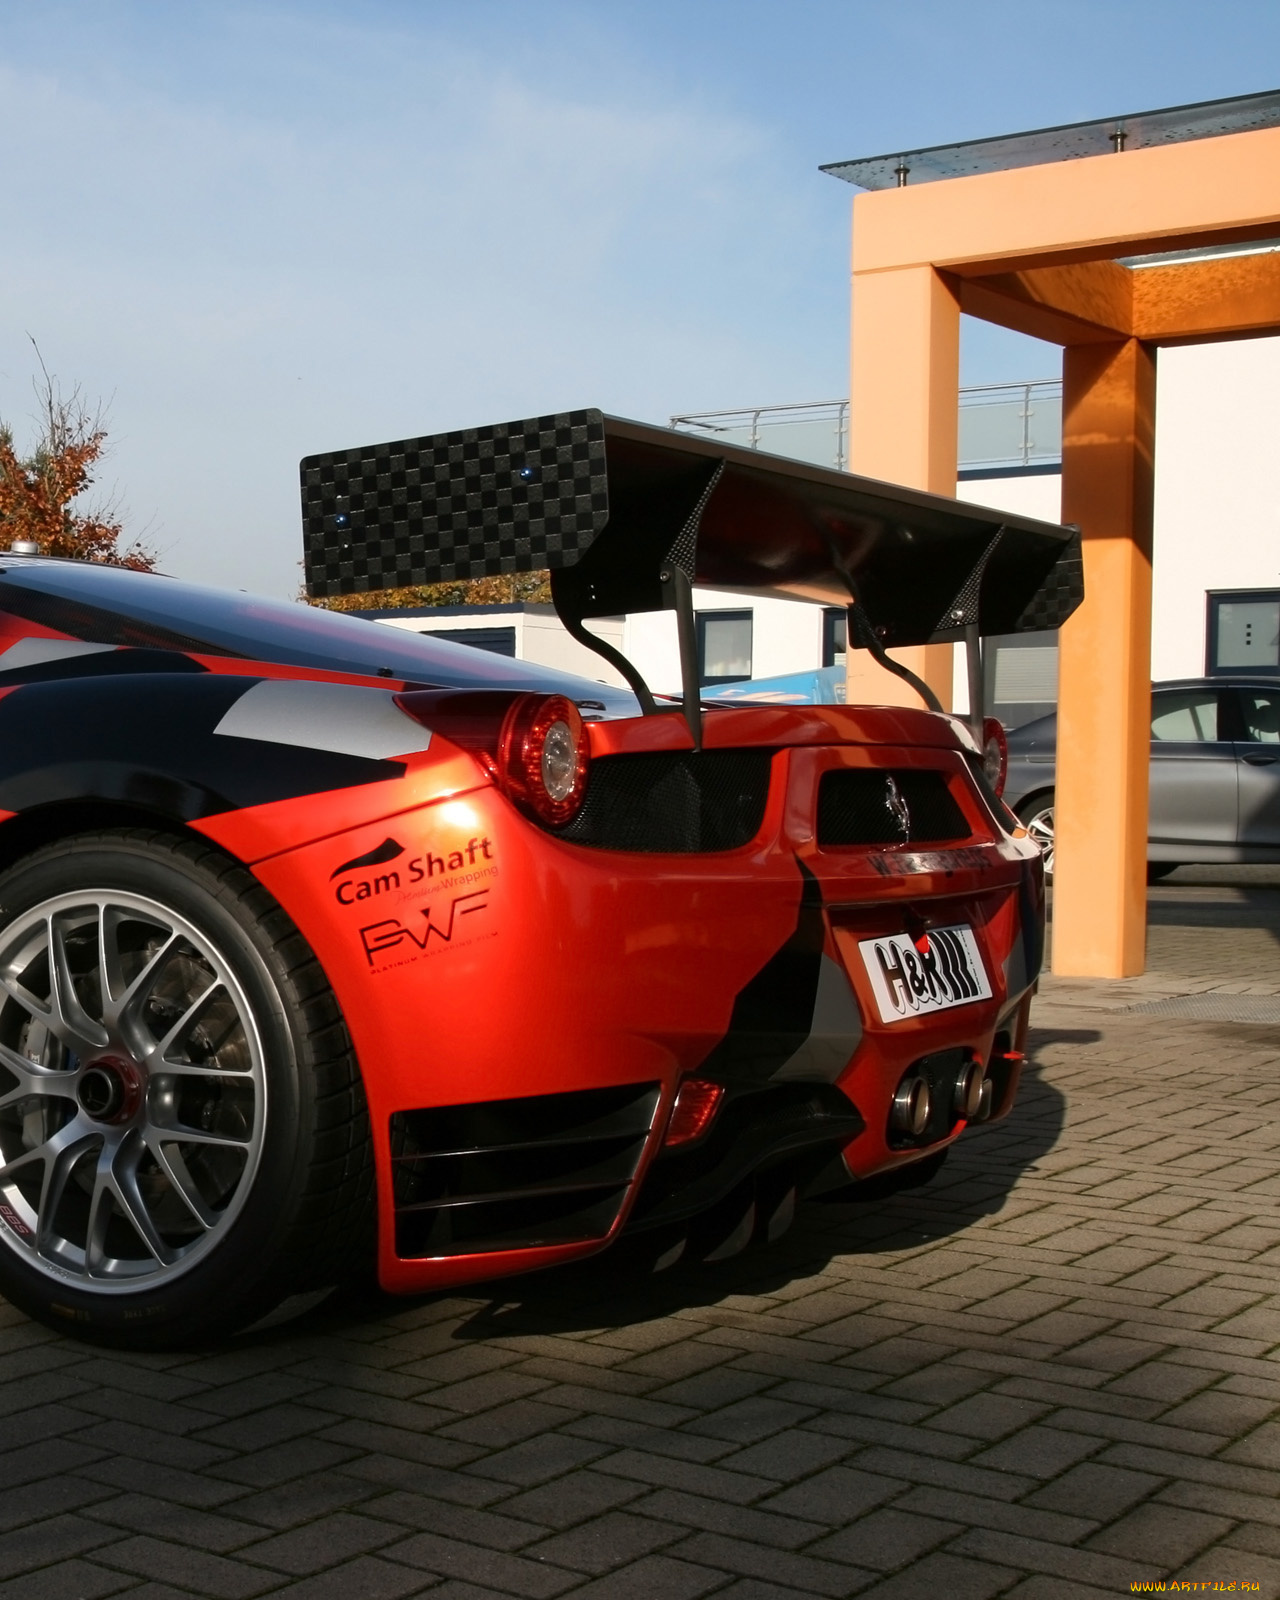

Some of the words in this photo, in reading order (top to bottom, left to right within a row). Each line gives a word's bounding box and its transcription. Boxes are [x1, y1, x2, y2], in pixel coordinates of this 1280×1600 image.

[335, 871, 401, 906] Cam
[408, 837, 494, 883] Shaft
[441, 865, 499, 890] Wrapping
[370, 955, 419, 975] PLATINUM
